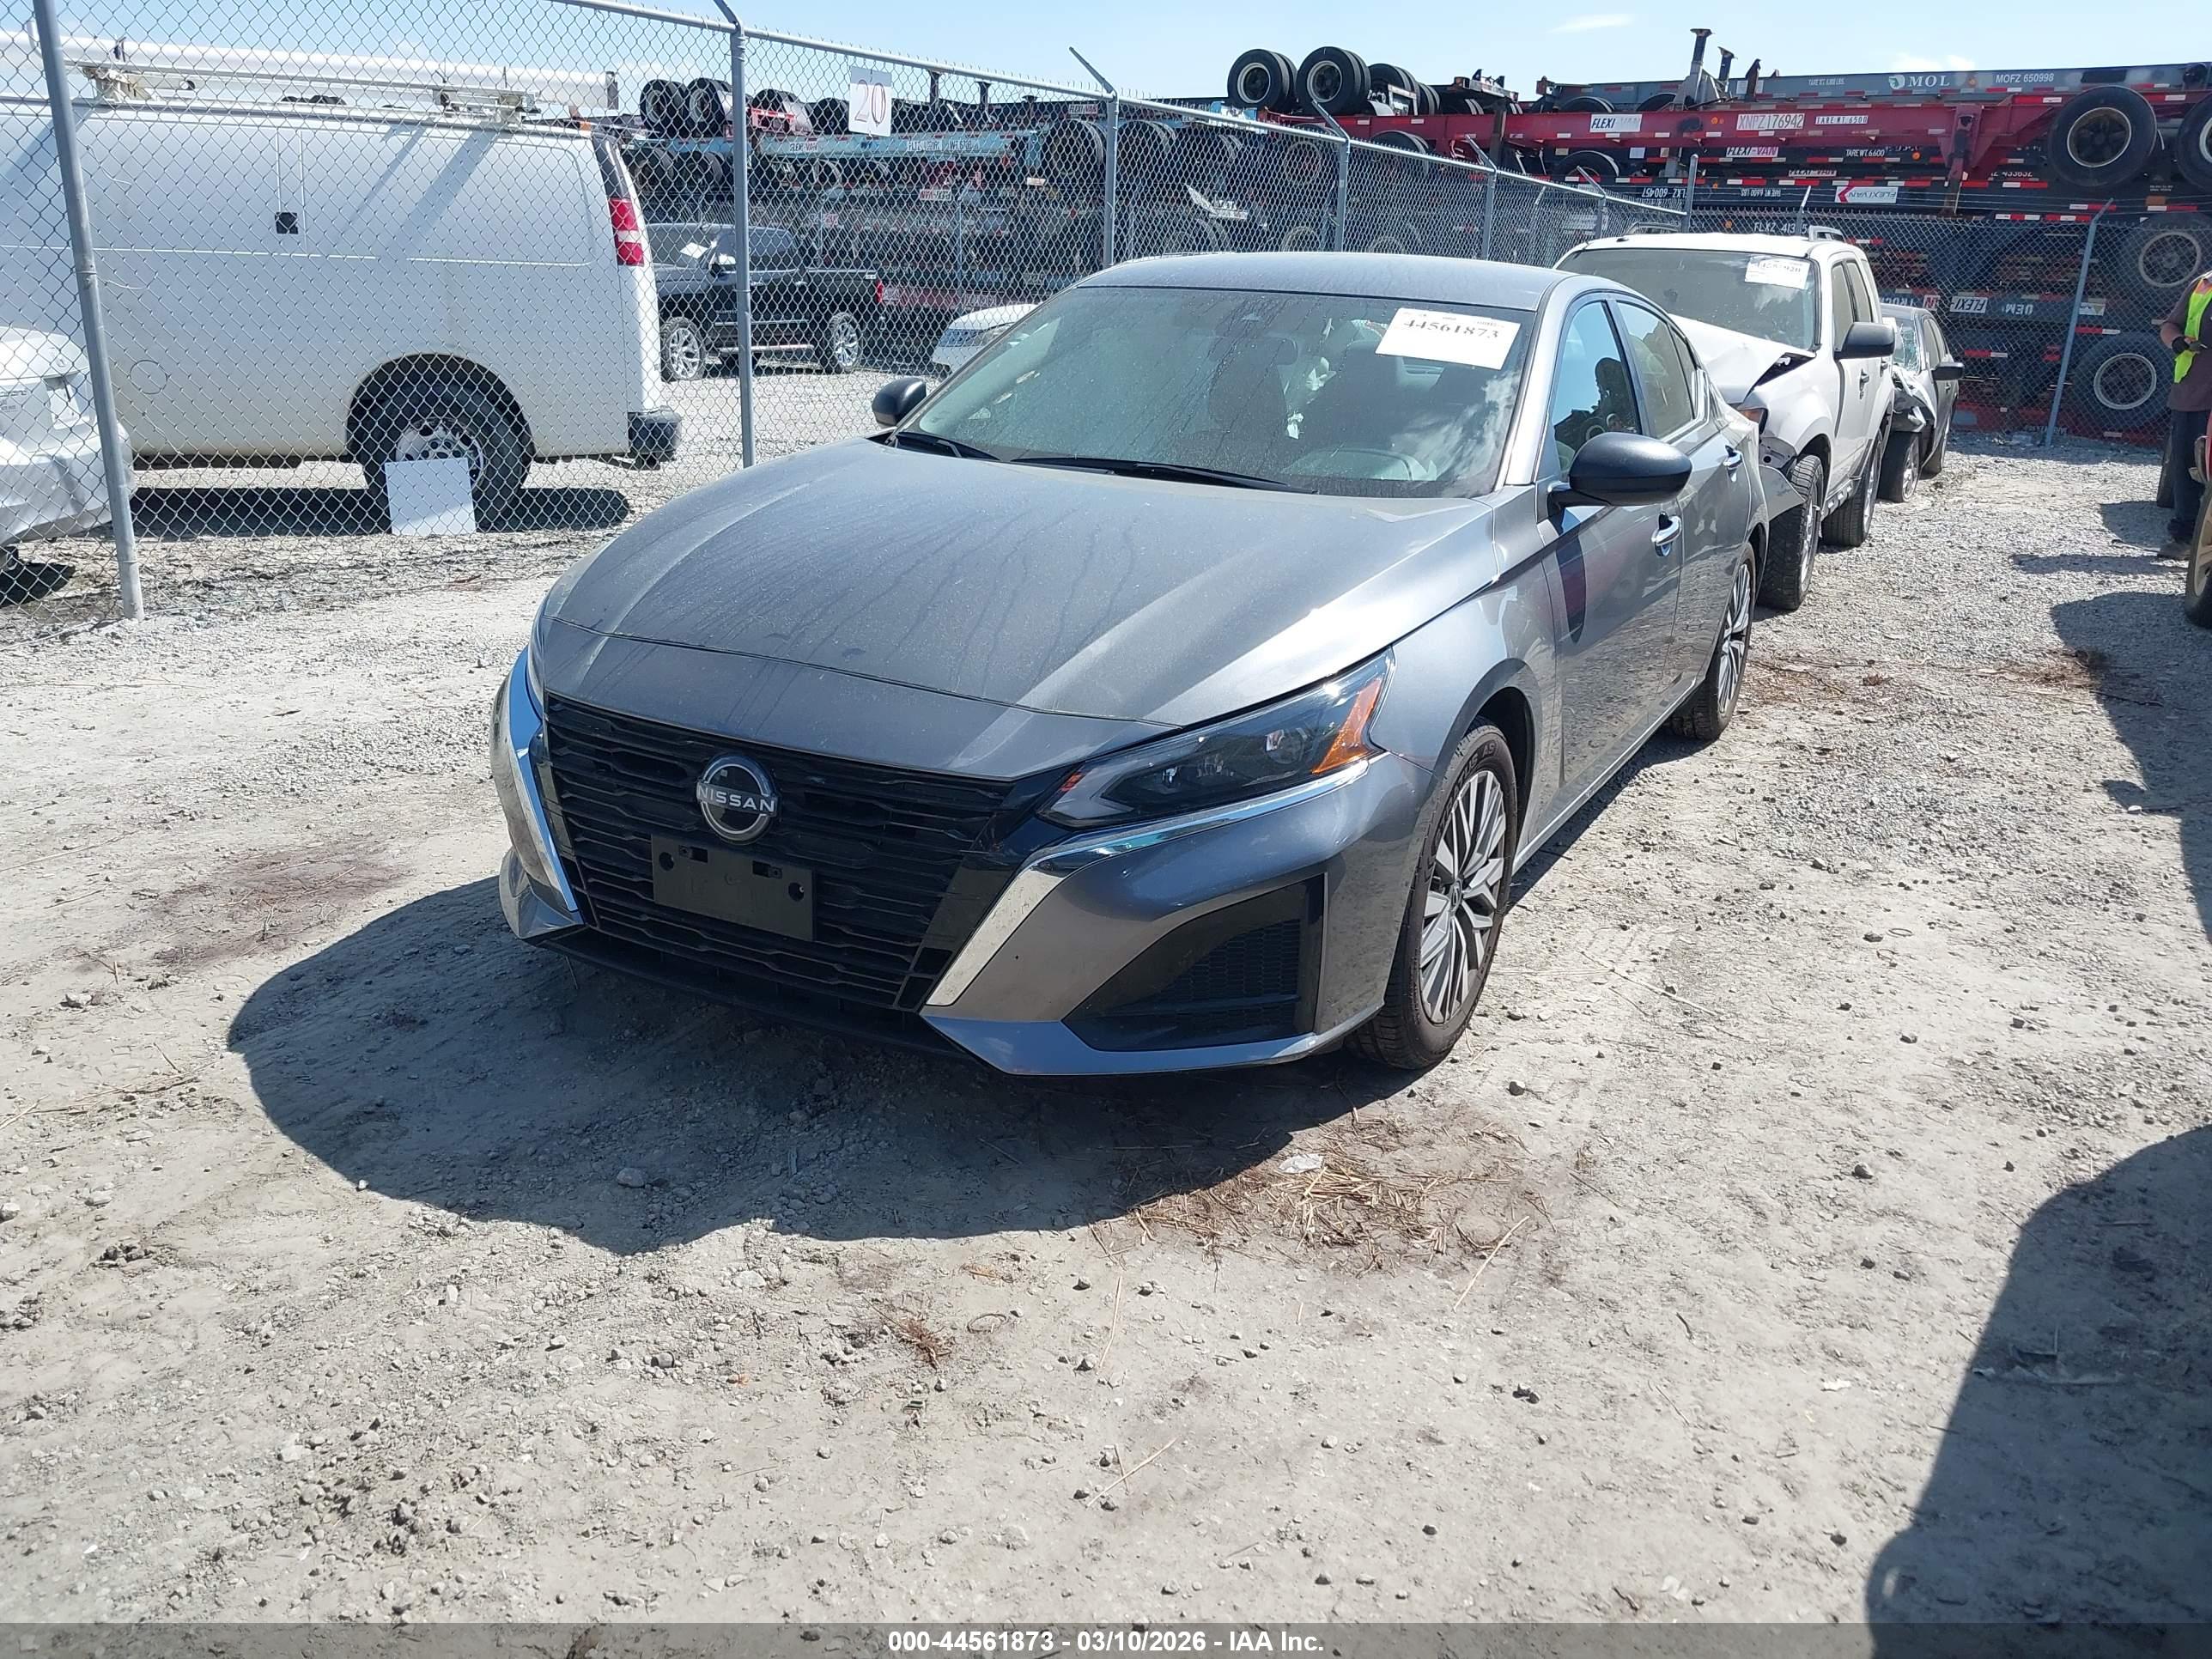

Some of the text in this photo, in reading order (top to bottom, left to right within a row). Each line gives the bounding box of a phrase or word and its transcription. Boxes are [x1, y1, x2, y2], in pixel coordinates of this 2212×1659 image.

[1908, 75, 1950, 88] MOL
[1996, 72, 2055, 84] MOFZ 650998
[854, 79, 887, 126] 20
[1591, 118, 1616, 130] FLEXI
[1737, 113, 1805, 130] XNPZ176942
[1816, 116, 1834, 125] TARE
[1848, 115, 1868, 124] 6500
[1753, 222, 1777, 233] FLXZ
[1404, 319, 1498, 338] 44561873
[696, 785, 775, 811] NISSAN
